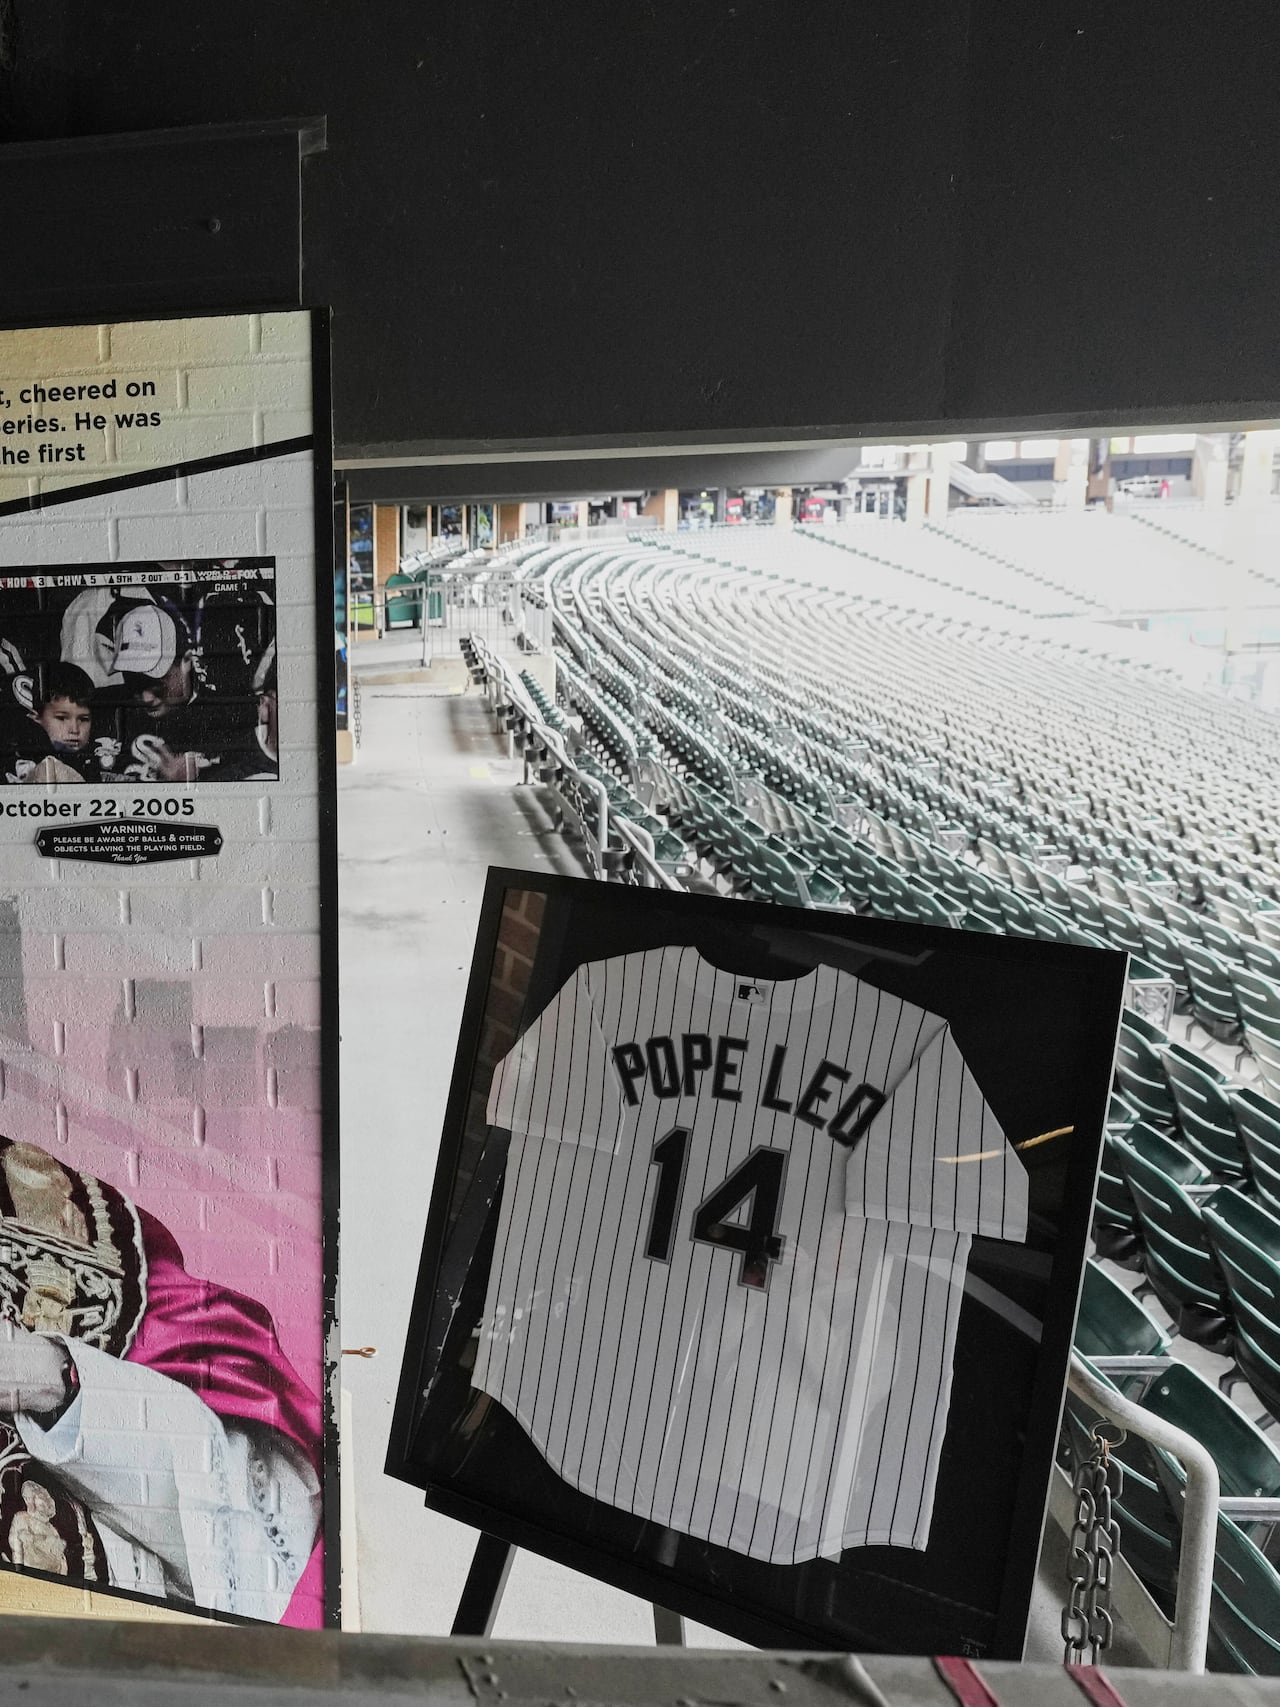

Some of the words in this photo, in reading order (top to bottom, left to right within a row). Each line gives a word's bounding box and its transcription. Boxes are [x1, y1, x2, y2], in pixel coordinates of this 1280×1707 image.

[19, 379, 117, 403] cheered
[125, 381, 156, 397] on
[75, 411, 107, 431] He
[115, 411, 161, 428] was
[38, 443, 86, 463] first
[6, 577, 27, 589] HOU
[38, 577, 45, 586] 3
[57, 575, 82, 587] CHW
[90, 576, 97, 584] 5
[141, 574, 148, 582] 2
[148, 574, 163, 582] OUT
[237, 569, 259, 580] FOX
[214, 583, 238, 592] GAME
[89, 799, 124, 818] 22,
[132, 798, 195, 816] 2005
[100, 825, 157, 834] WARNING!
[168, 833, 176, 842] &
[111, 853, 133, 861] Thank
[134, 853, 148, 863] You
[611, 1032, 749, 1108] POPE
[760, 1044, 889, 1148] LEO
[642, 1124, 791, 1294] 14
